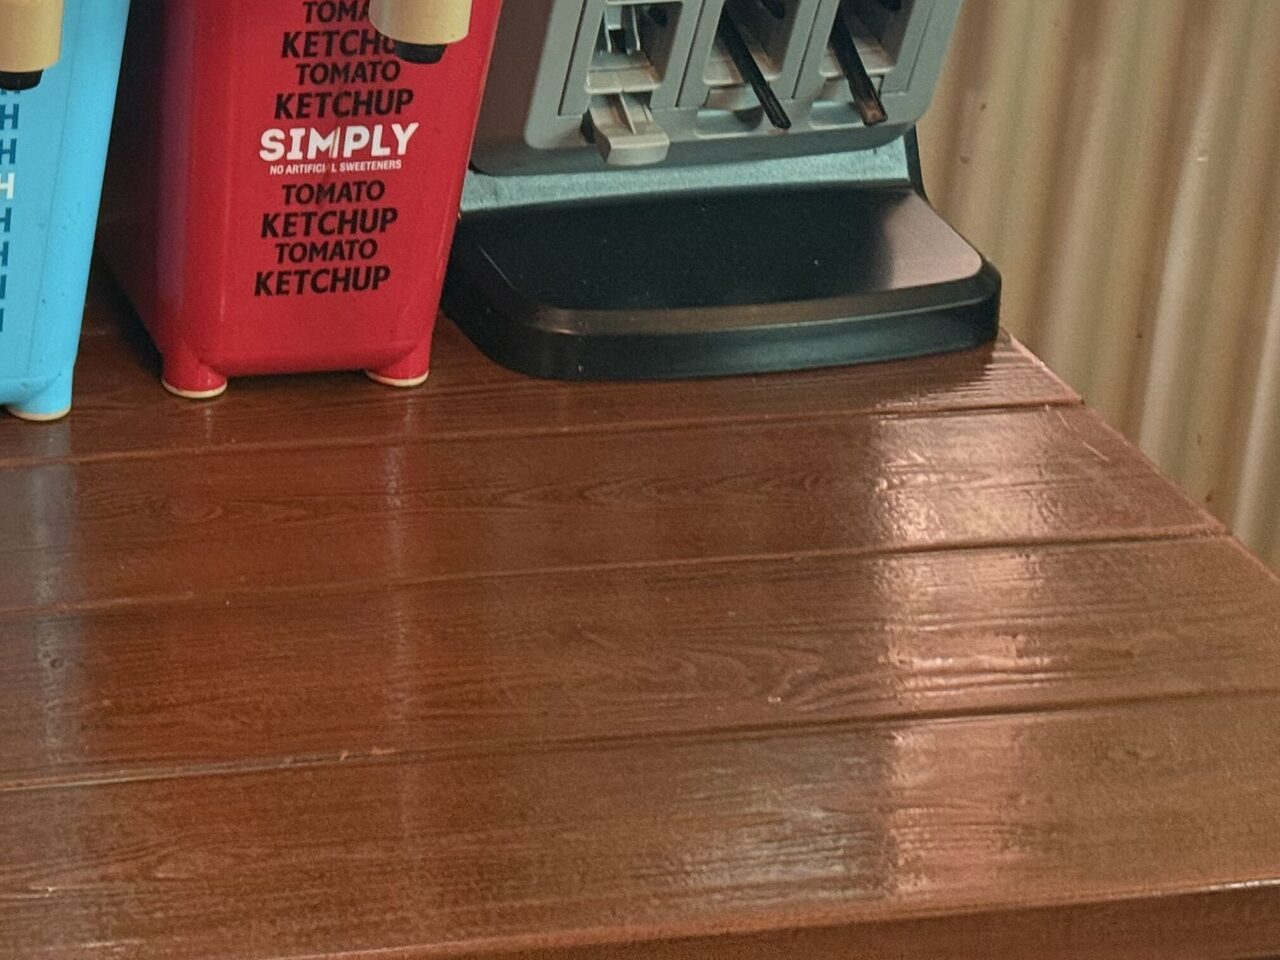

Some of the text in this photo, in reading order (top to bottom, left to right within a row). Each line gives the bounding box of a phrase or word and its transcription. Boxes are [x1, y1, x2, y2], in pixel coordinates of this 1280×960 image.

[295, 59, 402, 86] TOMATO
[273, 88, 415, 120] KETCHUP
[258, 122, 420, 162] SIMPLY
[269, 159, 403, 176] NO ARTIFICIL SWEETENERS
[281, 179, 386, 206] TOMATO
[260, 206, 399, 239] KETCHUP
[274, 237, 379, 265] TOMATO
[253, 264, 391, 297] KETCHUP
